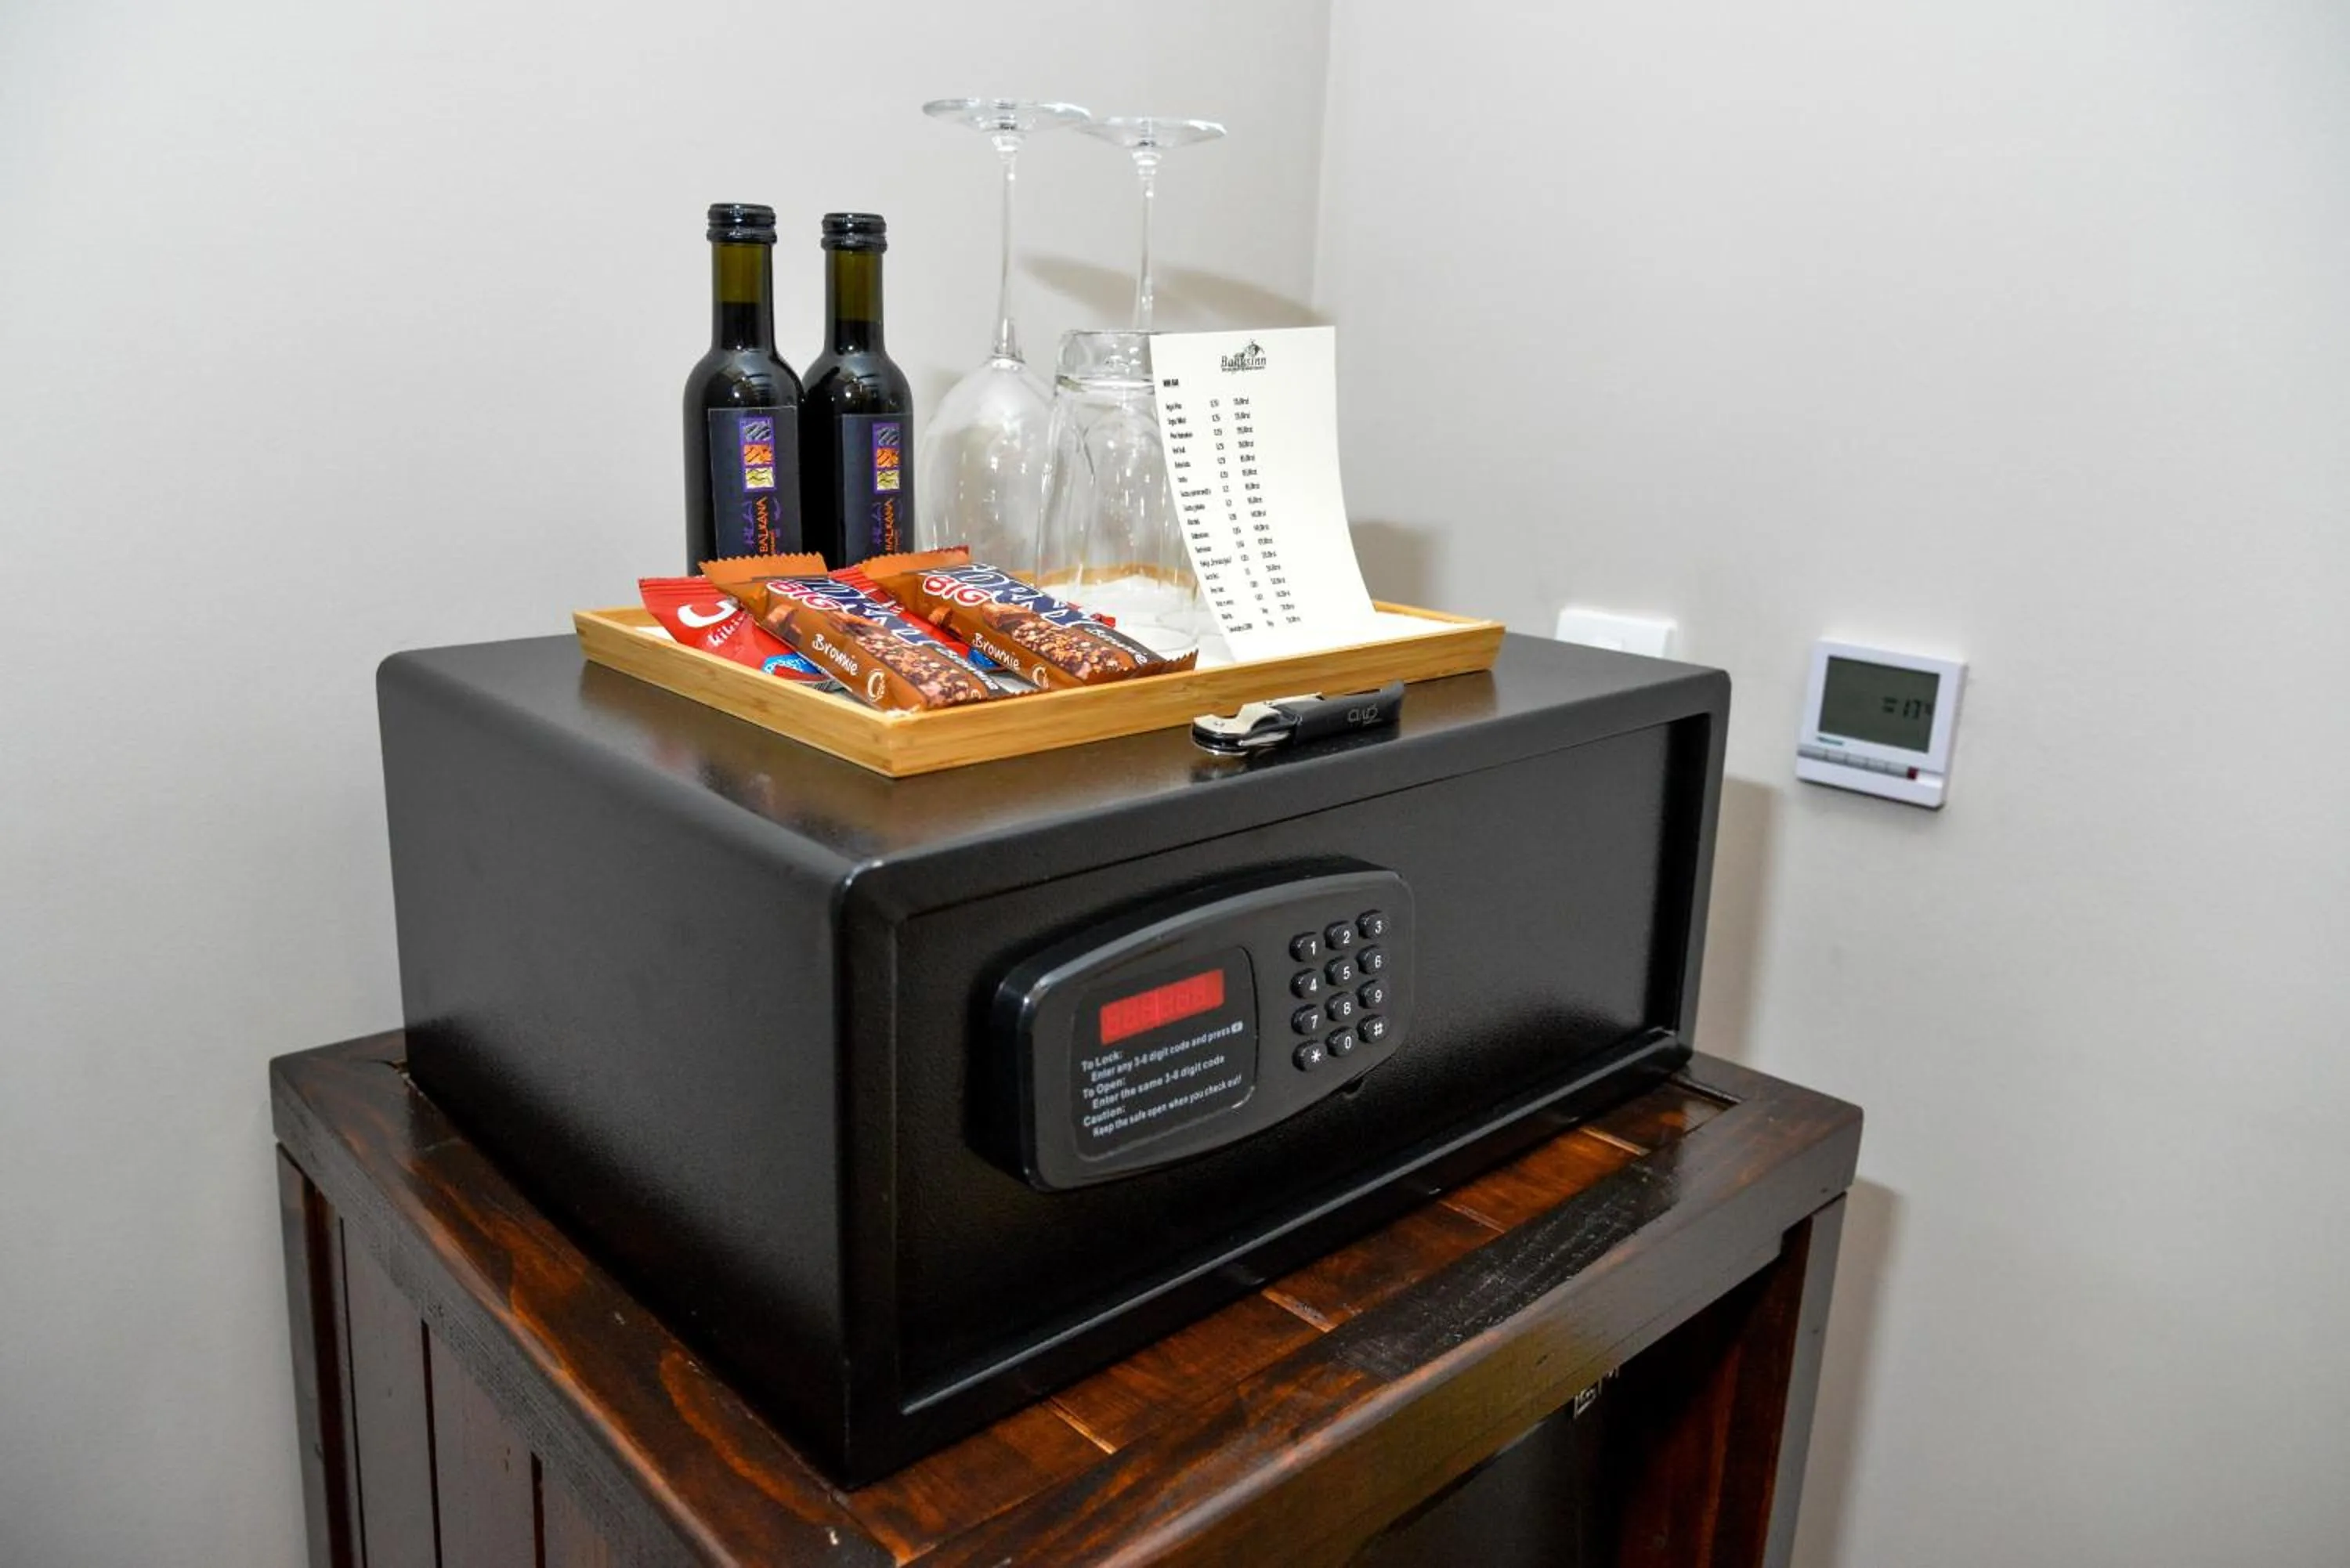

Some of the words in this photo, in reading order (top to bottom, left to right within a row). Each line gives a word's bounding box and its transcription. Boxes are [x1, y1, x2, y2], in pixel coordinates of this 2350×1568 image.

[756, 495, 769, 552] BALKANA
[923, 574, 990, 607] BIG
[812, 634, 859, 677] Brownie
[972, 632, 1021, 670] Brownie
[1311, 941, 1316, 956] 1
[1343, 930, 1350, 944] 2
[1375, 920, 1383, 934] 3
[1309, 978, 1317, 992] 4
[1343, 966, 1350, 980] 5
[1375, 955, 1382, 969] 6
[1311, 1015, 1318, 1028] 7
[1343, 1002, 1351, 1015] 8
[1375, 989, 1383, 1003] 9
[1082, 1060, 1094, 1072] To
[1094, 1050, 1123, 1067] Lock:
[1091, 1066, 1115, 1082] Enter
[1117, 1060, 1133, 1075] any
[1149, 1046, 1169, 1062] digit
[1170, 1039, 1190, 1053] code
[1191, 1033, 1206, 1047] and
[1207, 1027, 1230, 1043] press
[1344, 1036, 1351, 1050] 0
[1083, 1088, 1095, 1100] To
[1097, 1077, 1126, 1095] Open:
[1093, 1093, 1119, 1110] Enter
[1121, 1086, 1137, 1100] the
[1137, 1078, 1163, 1093] same
[1180, 1061, 1202, 1077] digit
[1202, 1054, 1225, 1069] code
[1083, 1105, 1126, 1128] Caution:
[1093, 1122, 1114, 1137] Keep
[1115, 1118, 1128, 1129] the
[1129, 1109, 1146, 1124] safe
[1148, 1103, 1166, 1118] open
[1168, 1095, 1188, 1109] when
[1189, 1089, 1204, 1104] you
[1204, 1081, 1227, 1097] check
